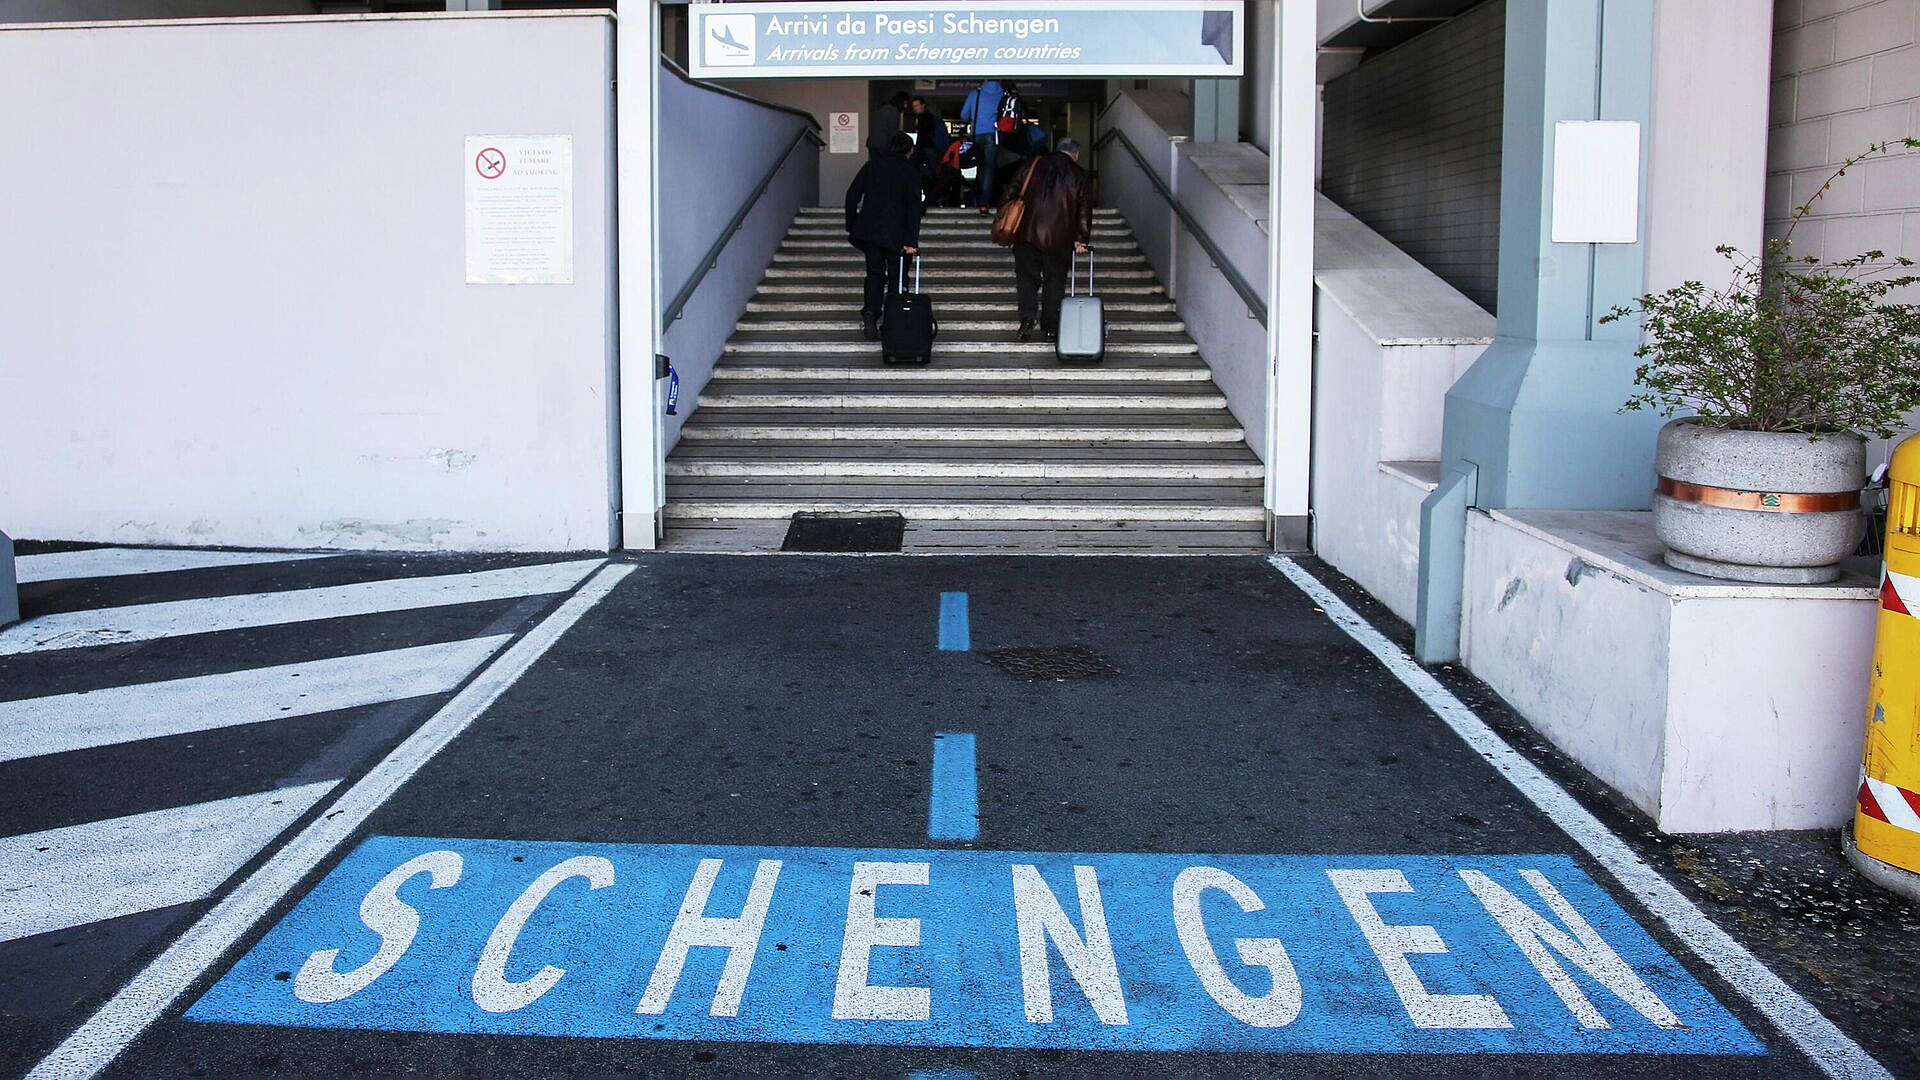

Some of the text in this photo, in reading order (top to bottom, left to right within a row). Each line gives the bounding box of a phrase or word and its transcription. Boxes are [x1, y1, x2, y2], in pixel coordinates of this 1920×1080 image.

[765, 11, 1059, 39] Arrivi da Paesi Schengen
[766, 42, 1082, 64] Arrivals from Schengen countries
[294, 850, 1685, 1030] SCHENGEN
